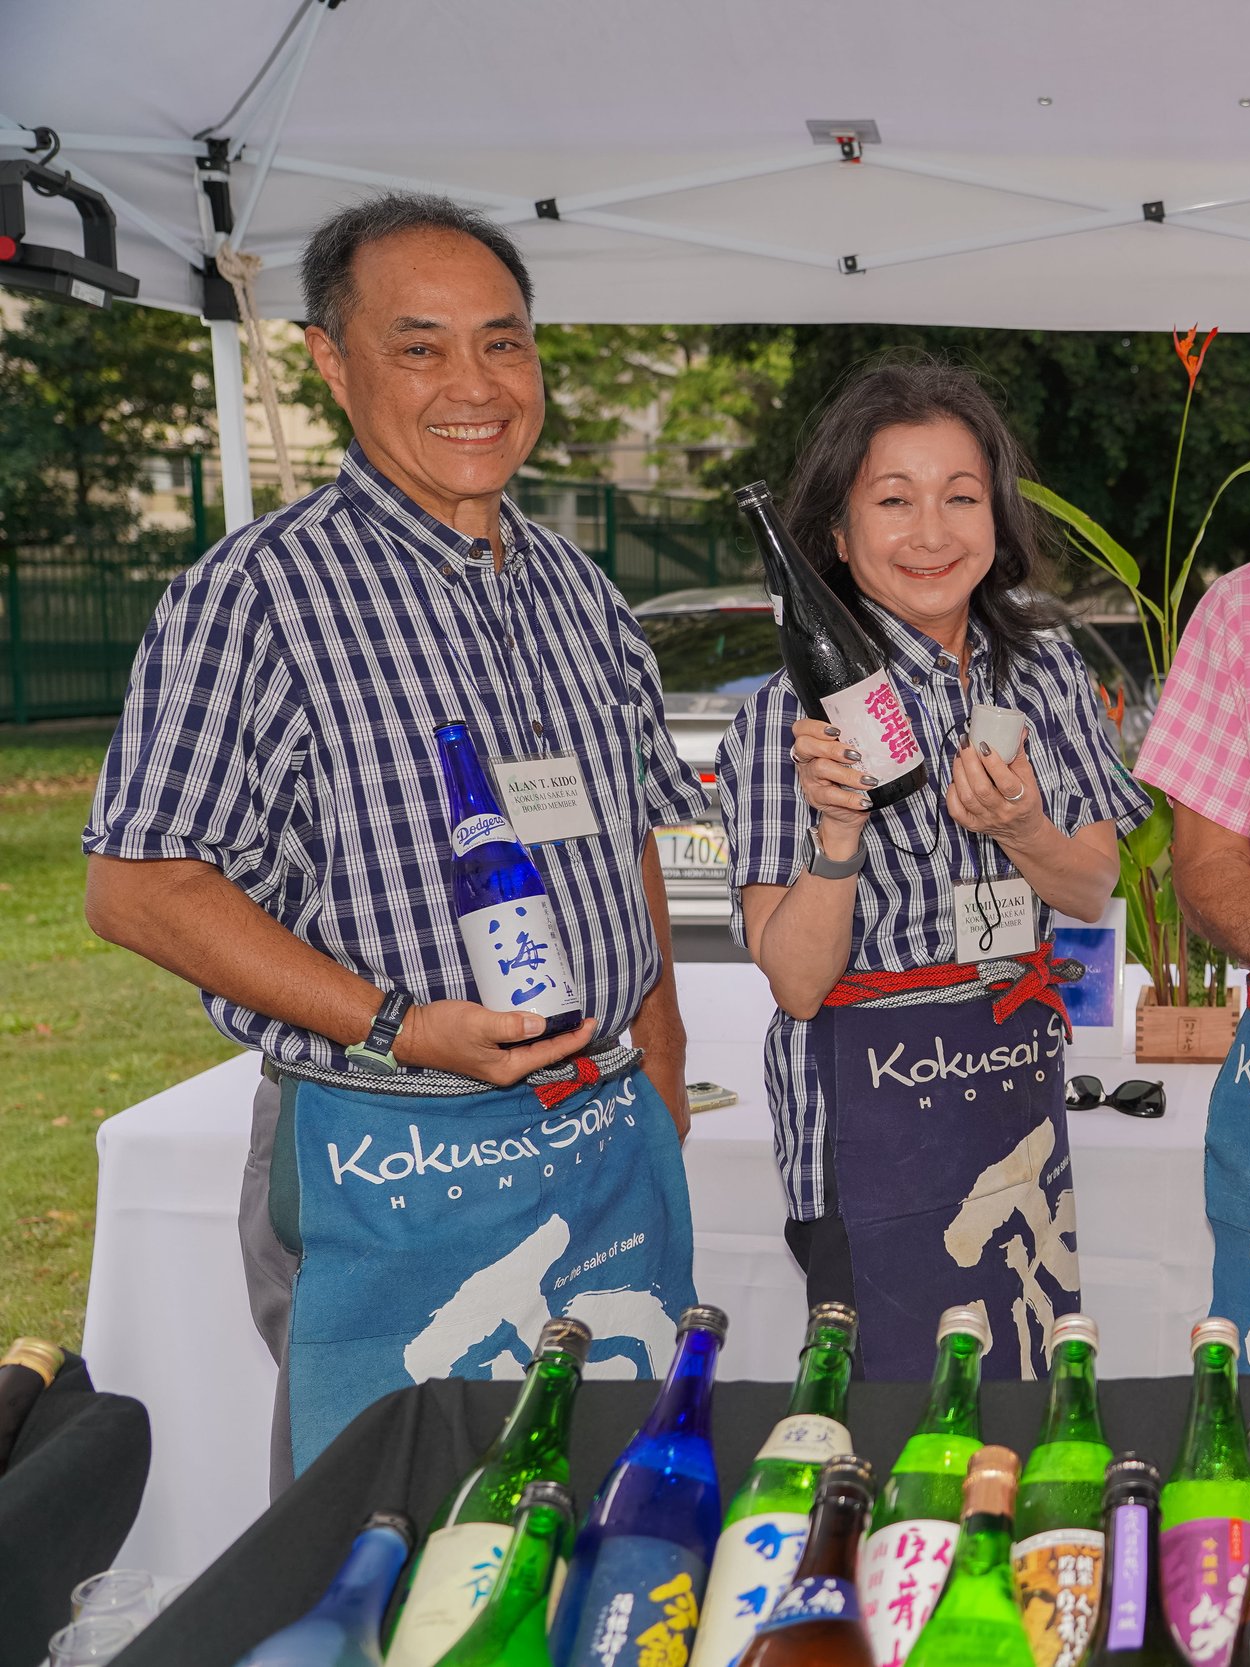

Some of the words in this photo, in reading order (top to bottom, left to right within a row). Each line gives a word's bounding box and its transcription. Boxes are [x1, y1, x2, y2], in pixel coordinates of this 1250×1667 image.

[508, 780, 538, 793] ALAN
[538, 779, 550, 789] T.
[550, 776, 577, 788] KIDO
[514, 793, 546, 804] KOKUSAI
[566, 789, 578, 798] KAI
[522, 803, 548, 813] BOARD
[548, 800, 577, 811] MEMBER
[457, 816, 505, 846] Dodgers
[867, 1029, 1039, 1089] Kokusai
[327, 1124, 540, 1185] Kokusai
[541, 1098, 616, 1149] Sake
[554, 1276, 569, 1290] for
[583, 1251, 607, 1271] sake
[608, 1241, 618, 1258] of
[620, 1232, 645, 1252] sake
